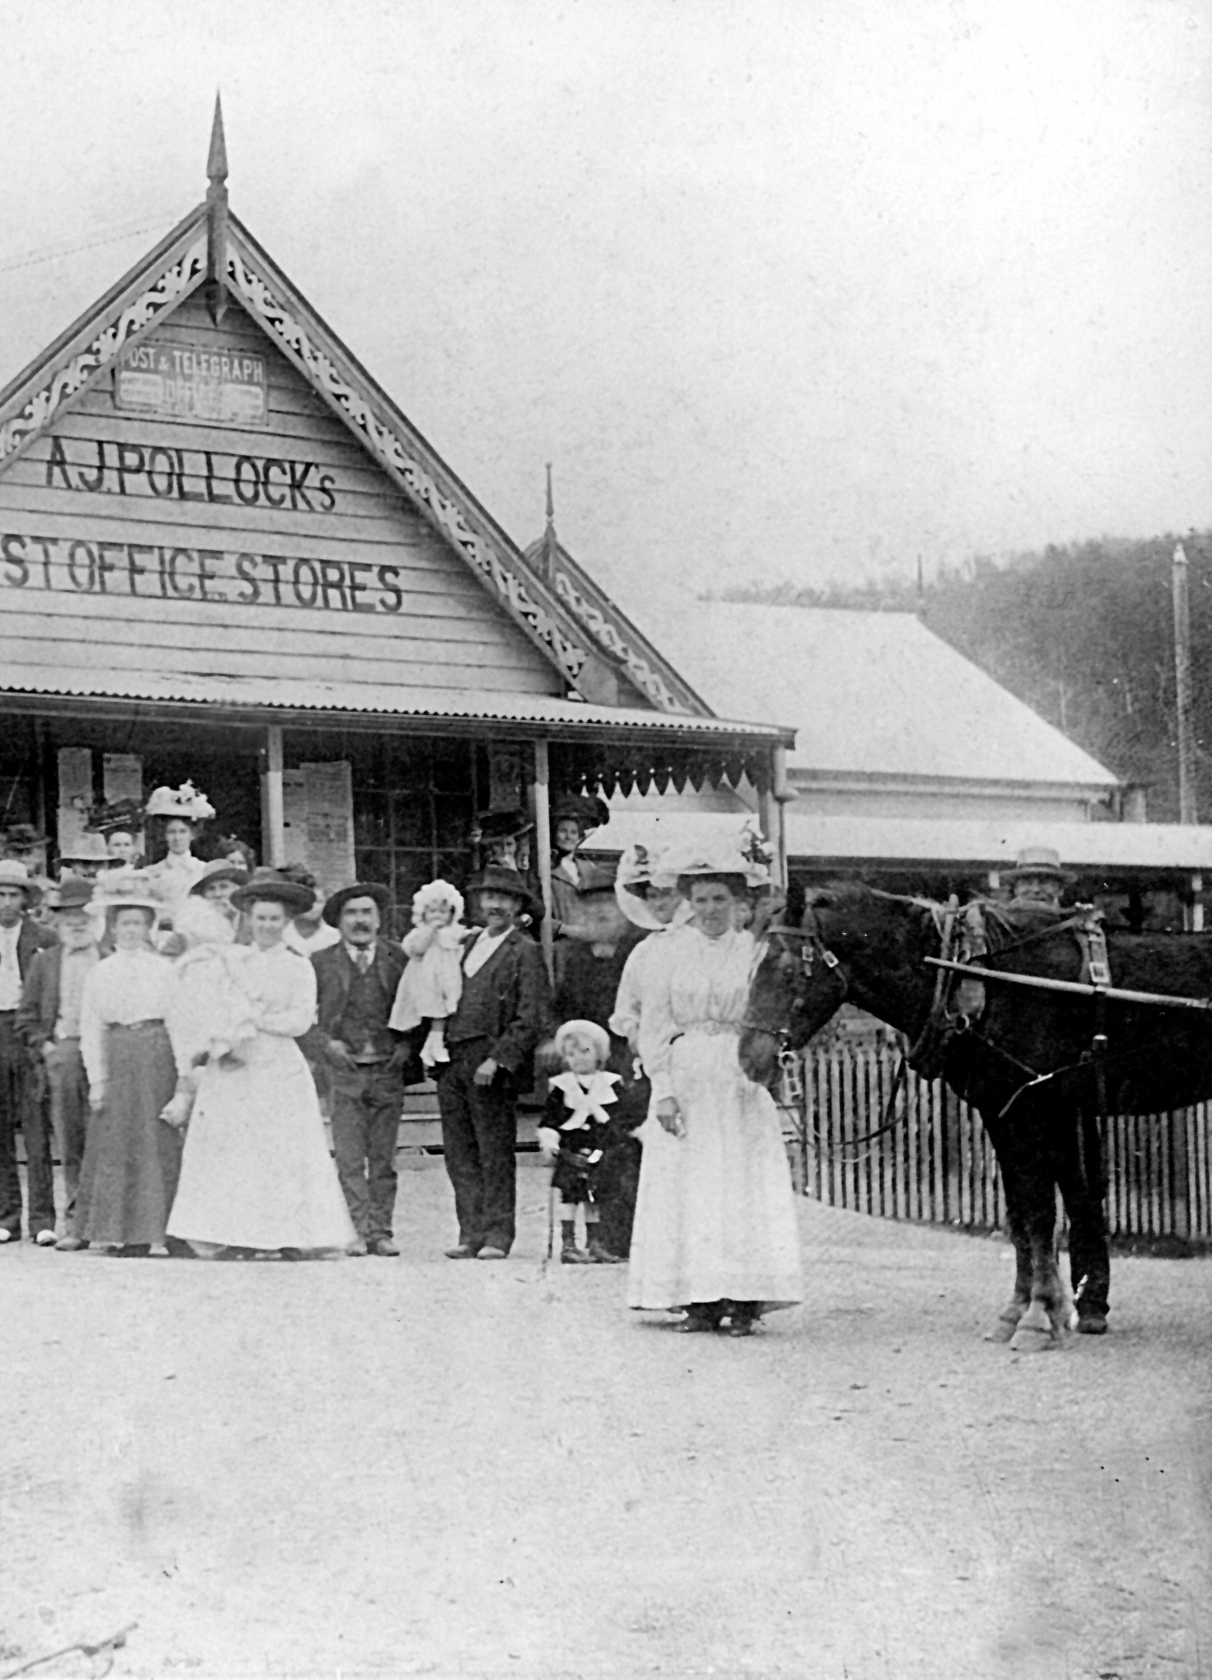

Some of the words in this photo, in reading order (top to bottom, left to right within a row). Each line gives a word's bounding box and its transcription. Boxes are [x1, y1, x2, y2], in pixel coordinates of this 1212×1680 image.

[159, 355, 170, 371] &
[173, 350, 263, 383] TELEGRAPH
[67, 541, 228, 603] OFFICE
[235, 552, 404, 613] STORES
